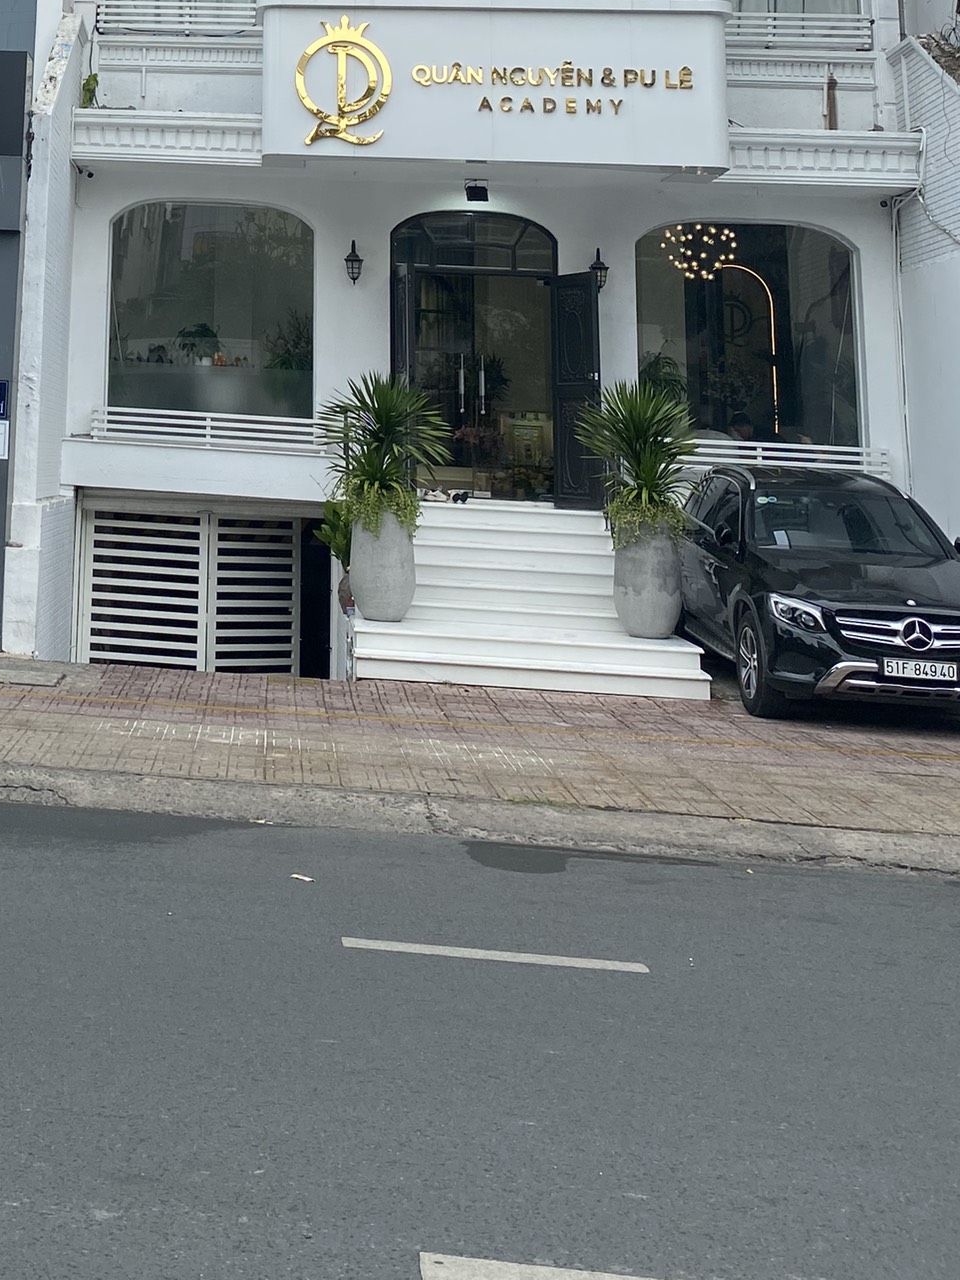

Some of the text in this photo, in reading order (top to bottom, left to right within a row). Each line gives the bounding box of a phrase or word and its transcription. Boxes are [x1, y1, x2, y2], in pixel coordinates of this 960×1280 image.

[411, 60, 694, 90] QUÂN NGUYỄN & PU LÊ
[478, 96, 624, 115] ACADEMY
[886, 661, 955, 679] 51F-849.40
